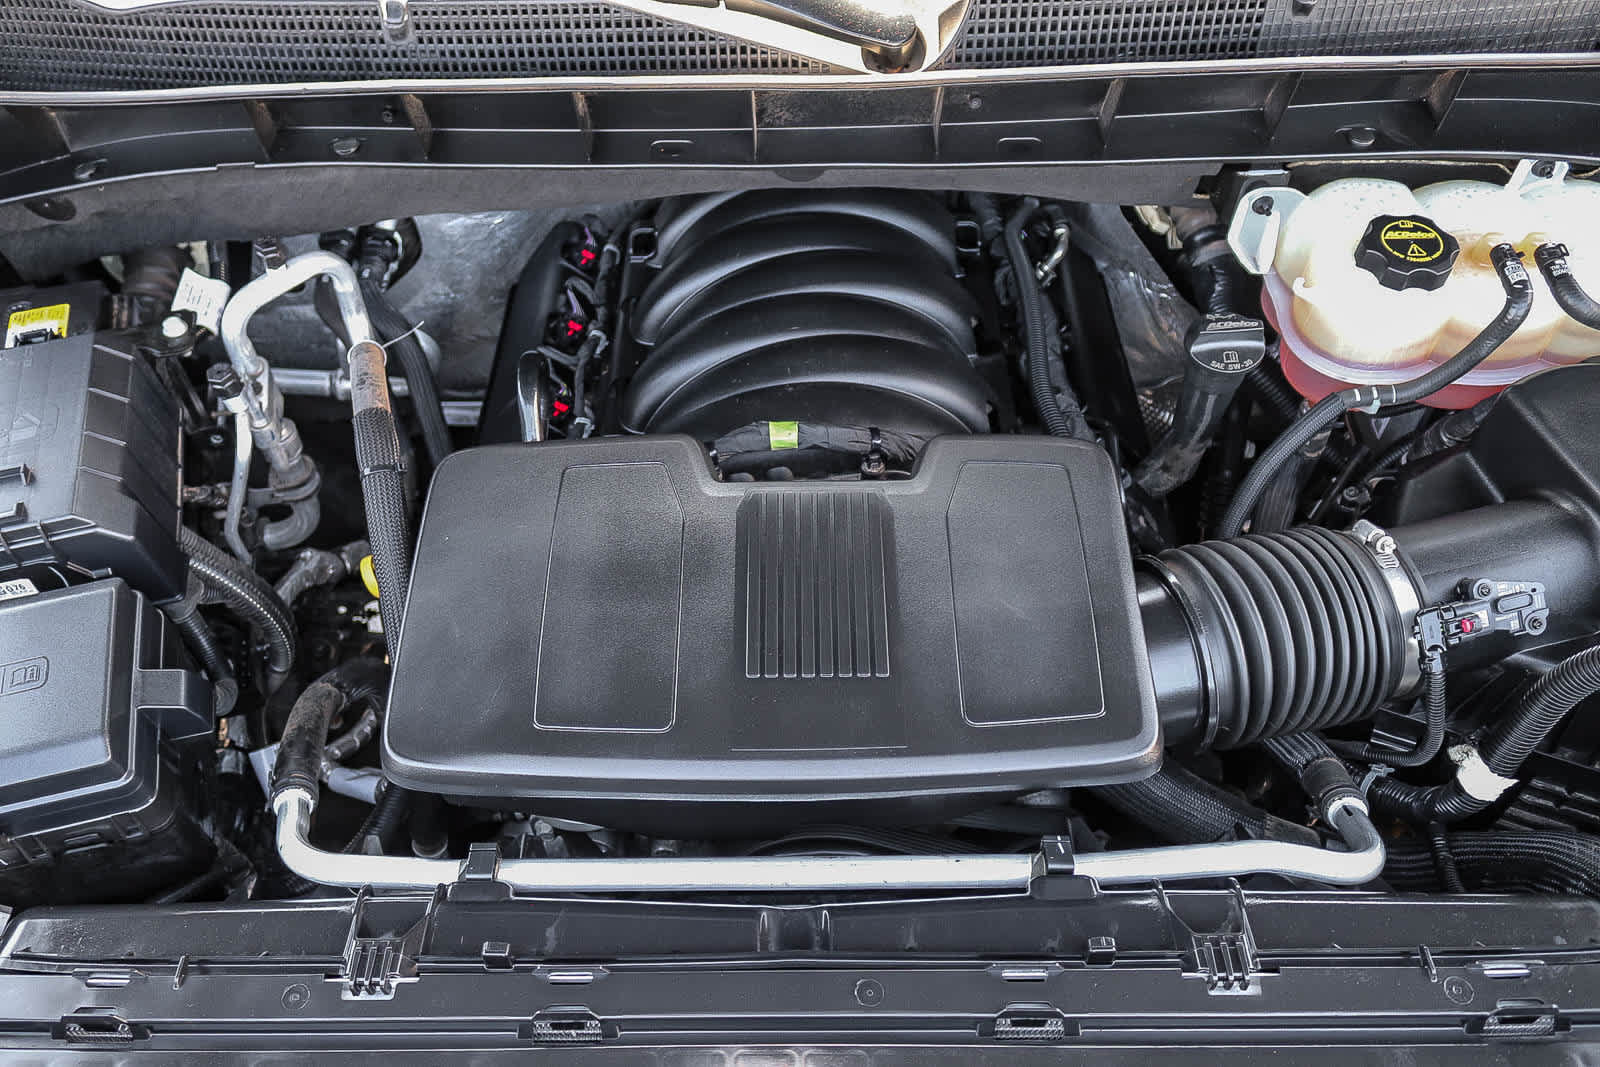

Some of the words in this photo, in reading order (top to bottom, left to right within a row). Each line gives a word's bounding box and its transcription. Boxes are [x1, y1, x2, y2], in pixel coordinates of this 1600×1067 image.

[1206, 320, 1259, 331] ACDelco
[1210, 360, 1226, 370] SAE
[1228, 358, 1254, 370] 5W-30
